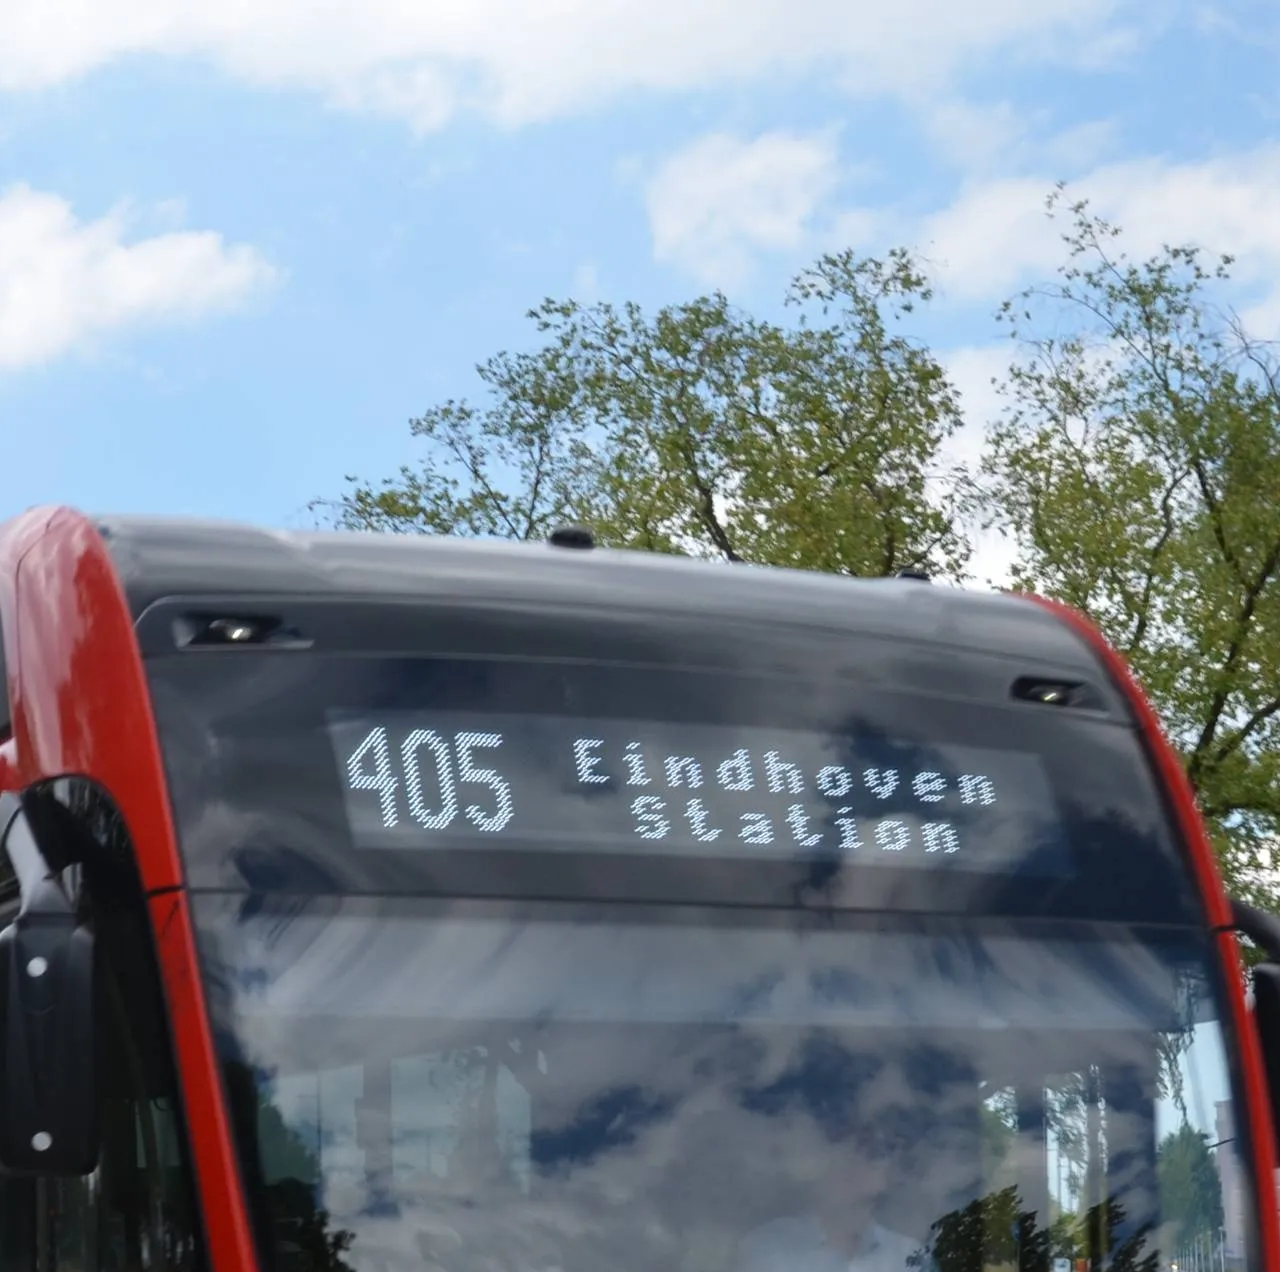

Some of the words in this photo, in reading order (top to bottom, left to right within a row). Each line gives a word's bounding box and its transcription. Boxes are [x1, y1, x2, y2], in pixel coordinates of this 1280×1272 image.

[346, 726, 516, 832] 405
[572, 738, 997, 807] Eindhoven
[630, 796, 961, 854] Station
